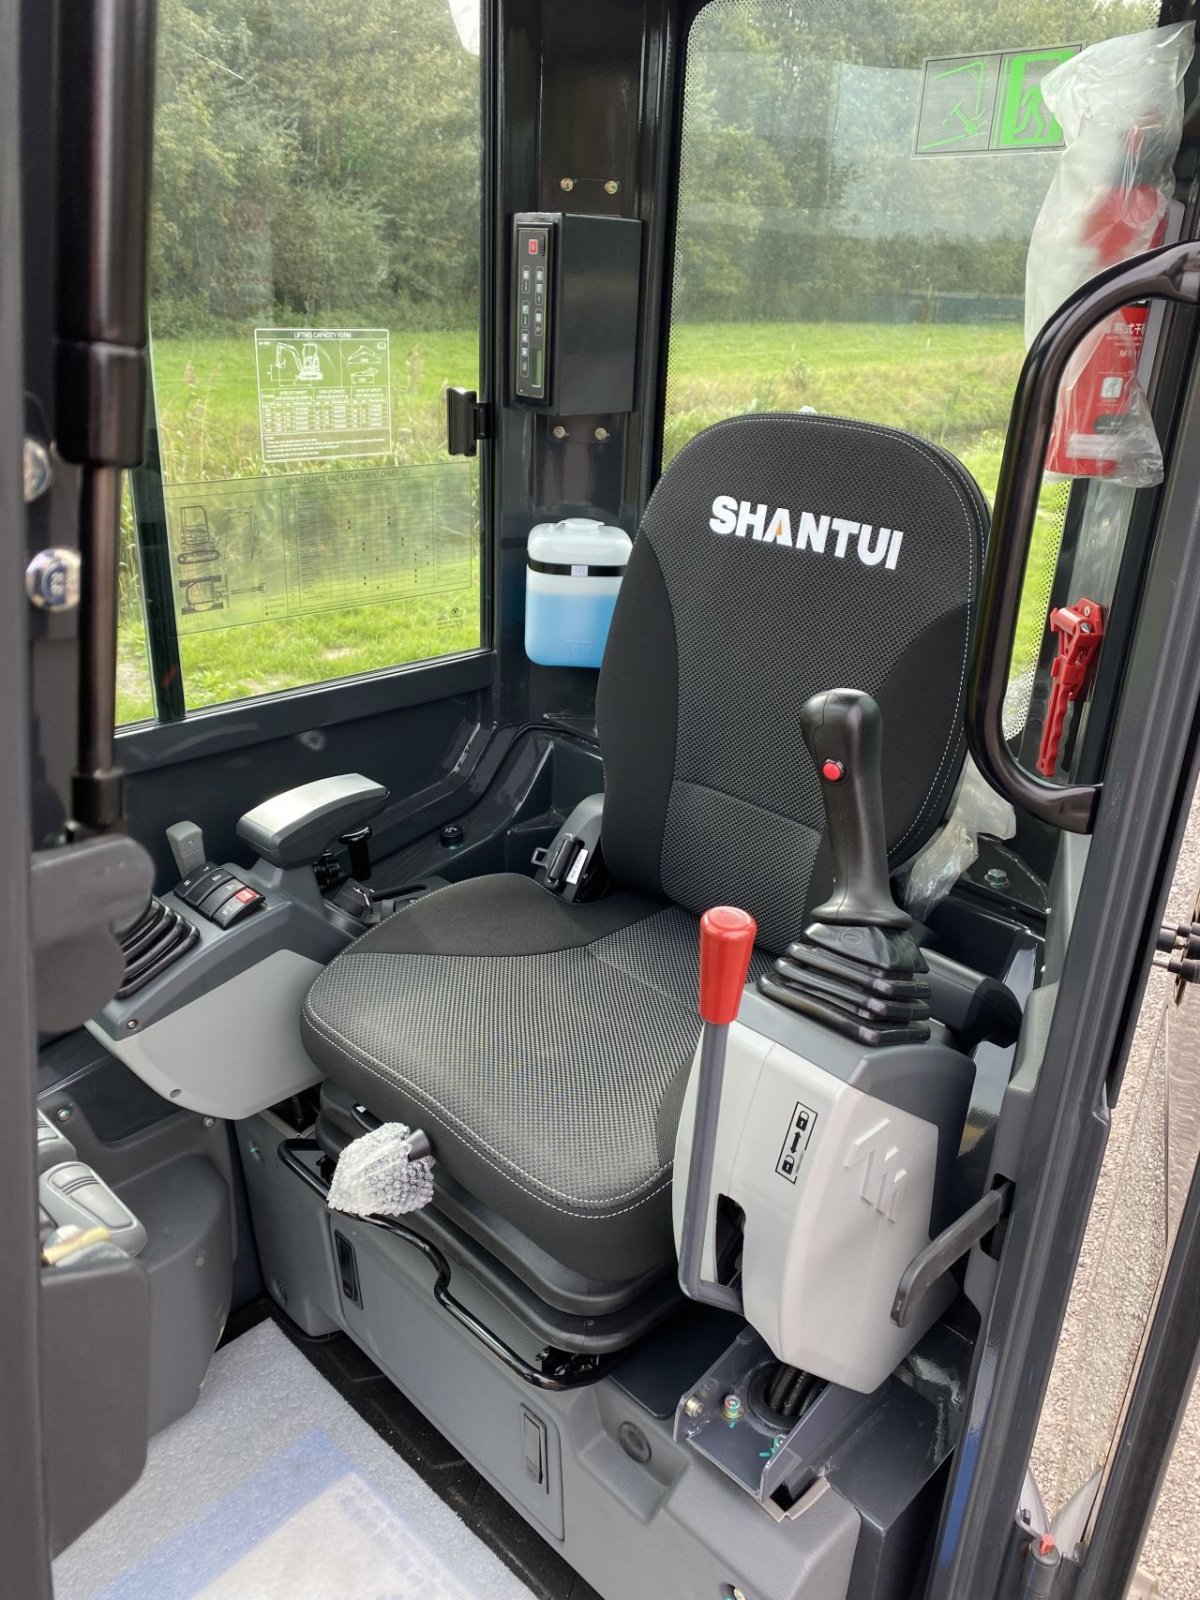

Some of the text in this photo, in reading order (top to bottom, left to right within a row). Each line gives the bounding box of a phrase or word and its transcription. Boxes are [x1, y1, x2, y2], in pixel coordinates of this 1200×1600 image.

[285, 469, 399, 486] MAINTENANCE AND REPLACEMENT CHART
[709, 495, 904, 570] SHANTUI
